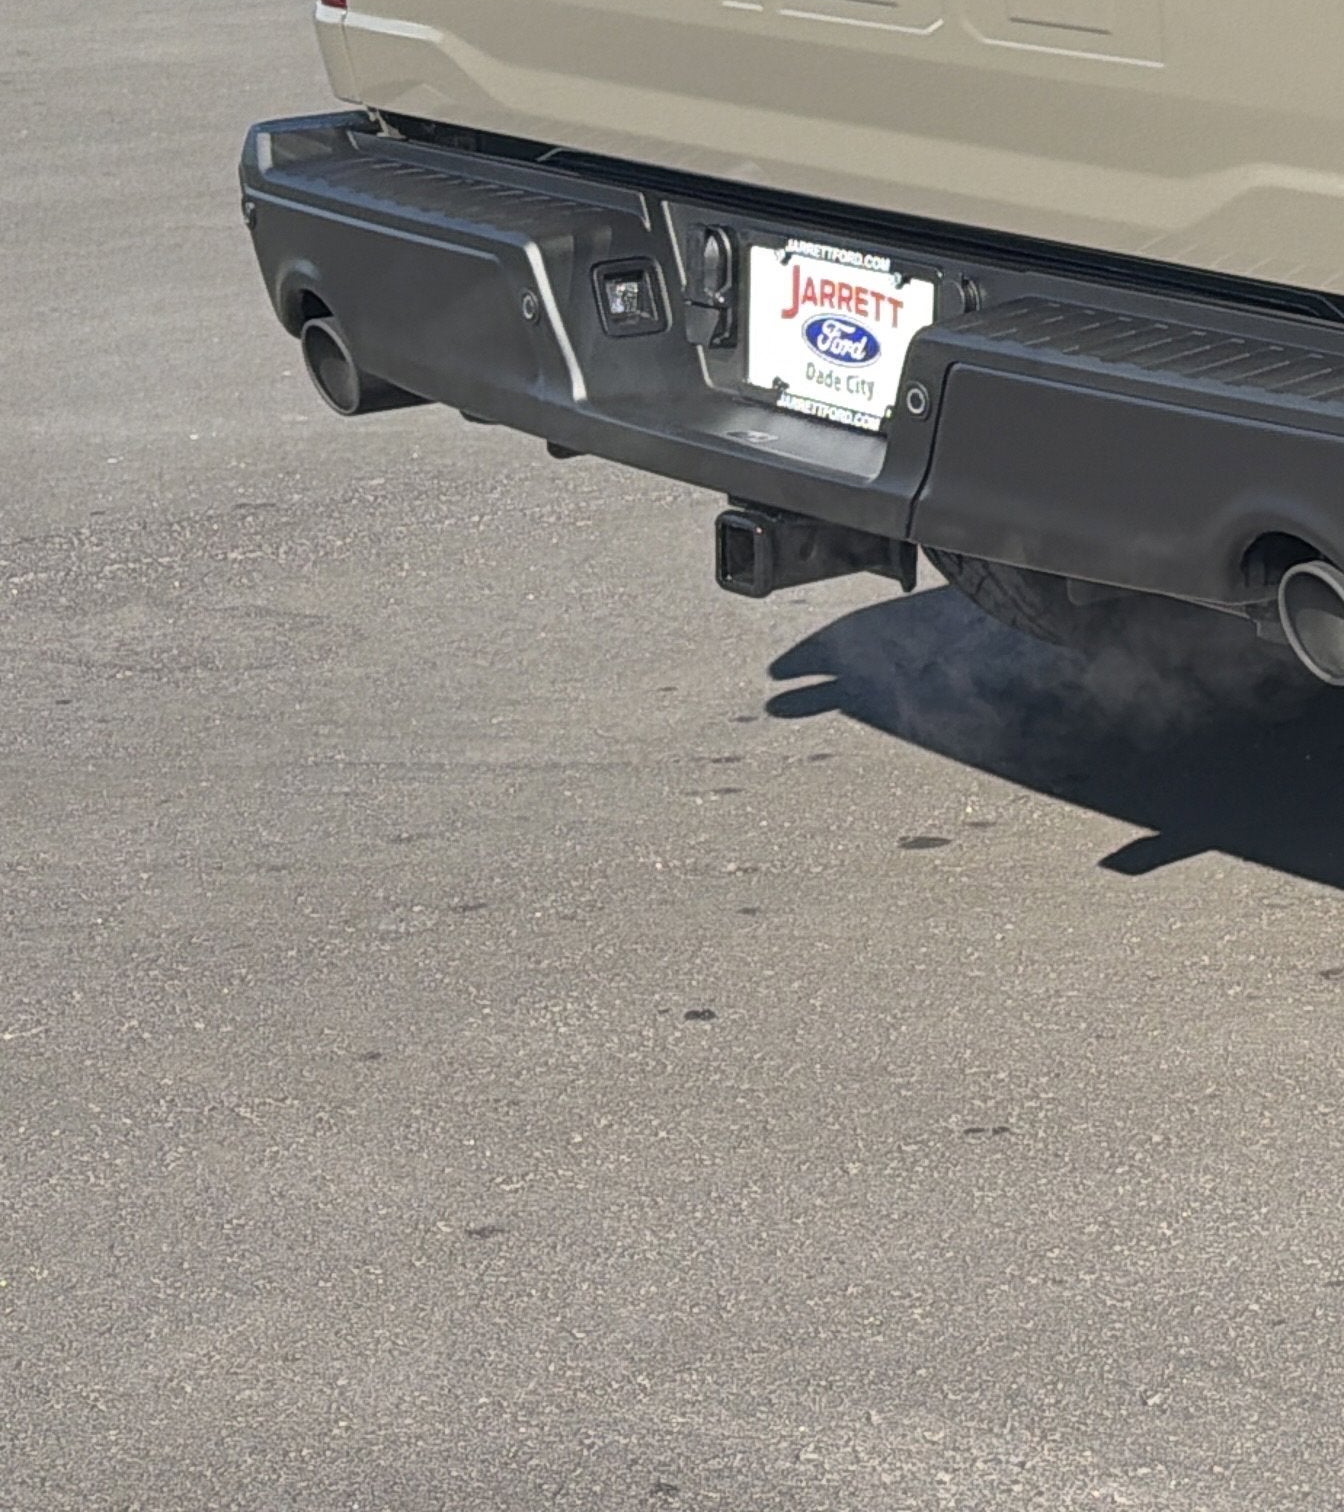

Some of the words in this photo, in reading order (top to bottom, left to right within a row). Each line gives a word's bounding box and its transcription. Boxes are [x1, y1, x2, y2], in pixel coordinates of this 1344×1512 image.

[784, 238, 891, 272] JARRETTFORD.COM
[781, 264, 904, 328] JARRETT
[816, 318, 867, 361] Ford
[806, 361, 841, 392] Dade
[846, 374, 875, 400] City
[776, 392, 881, 431] JARRETTFORD.COM
